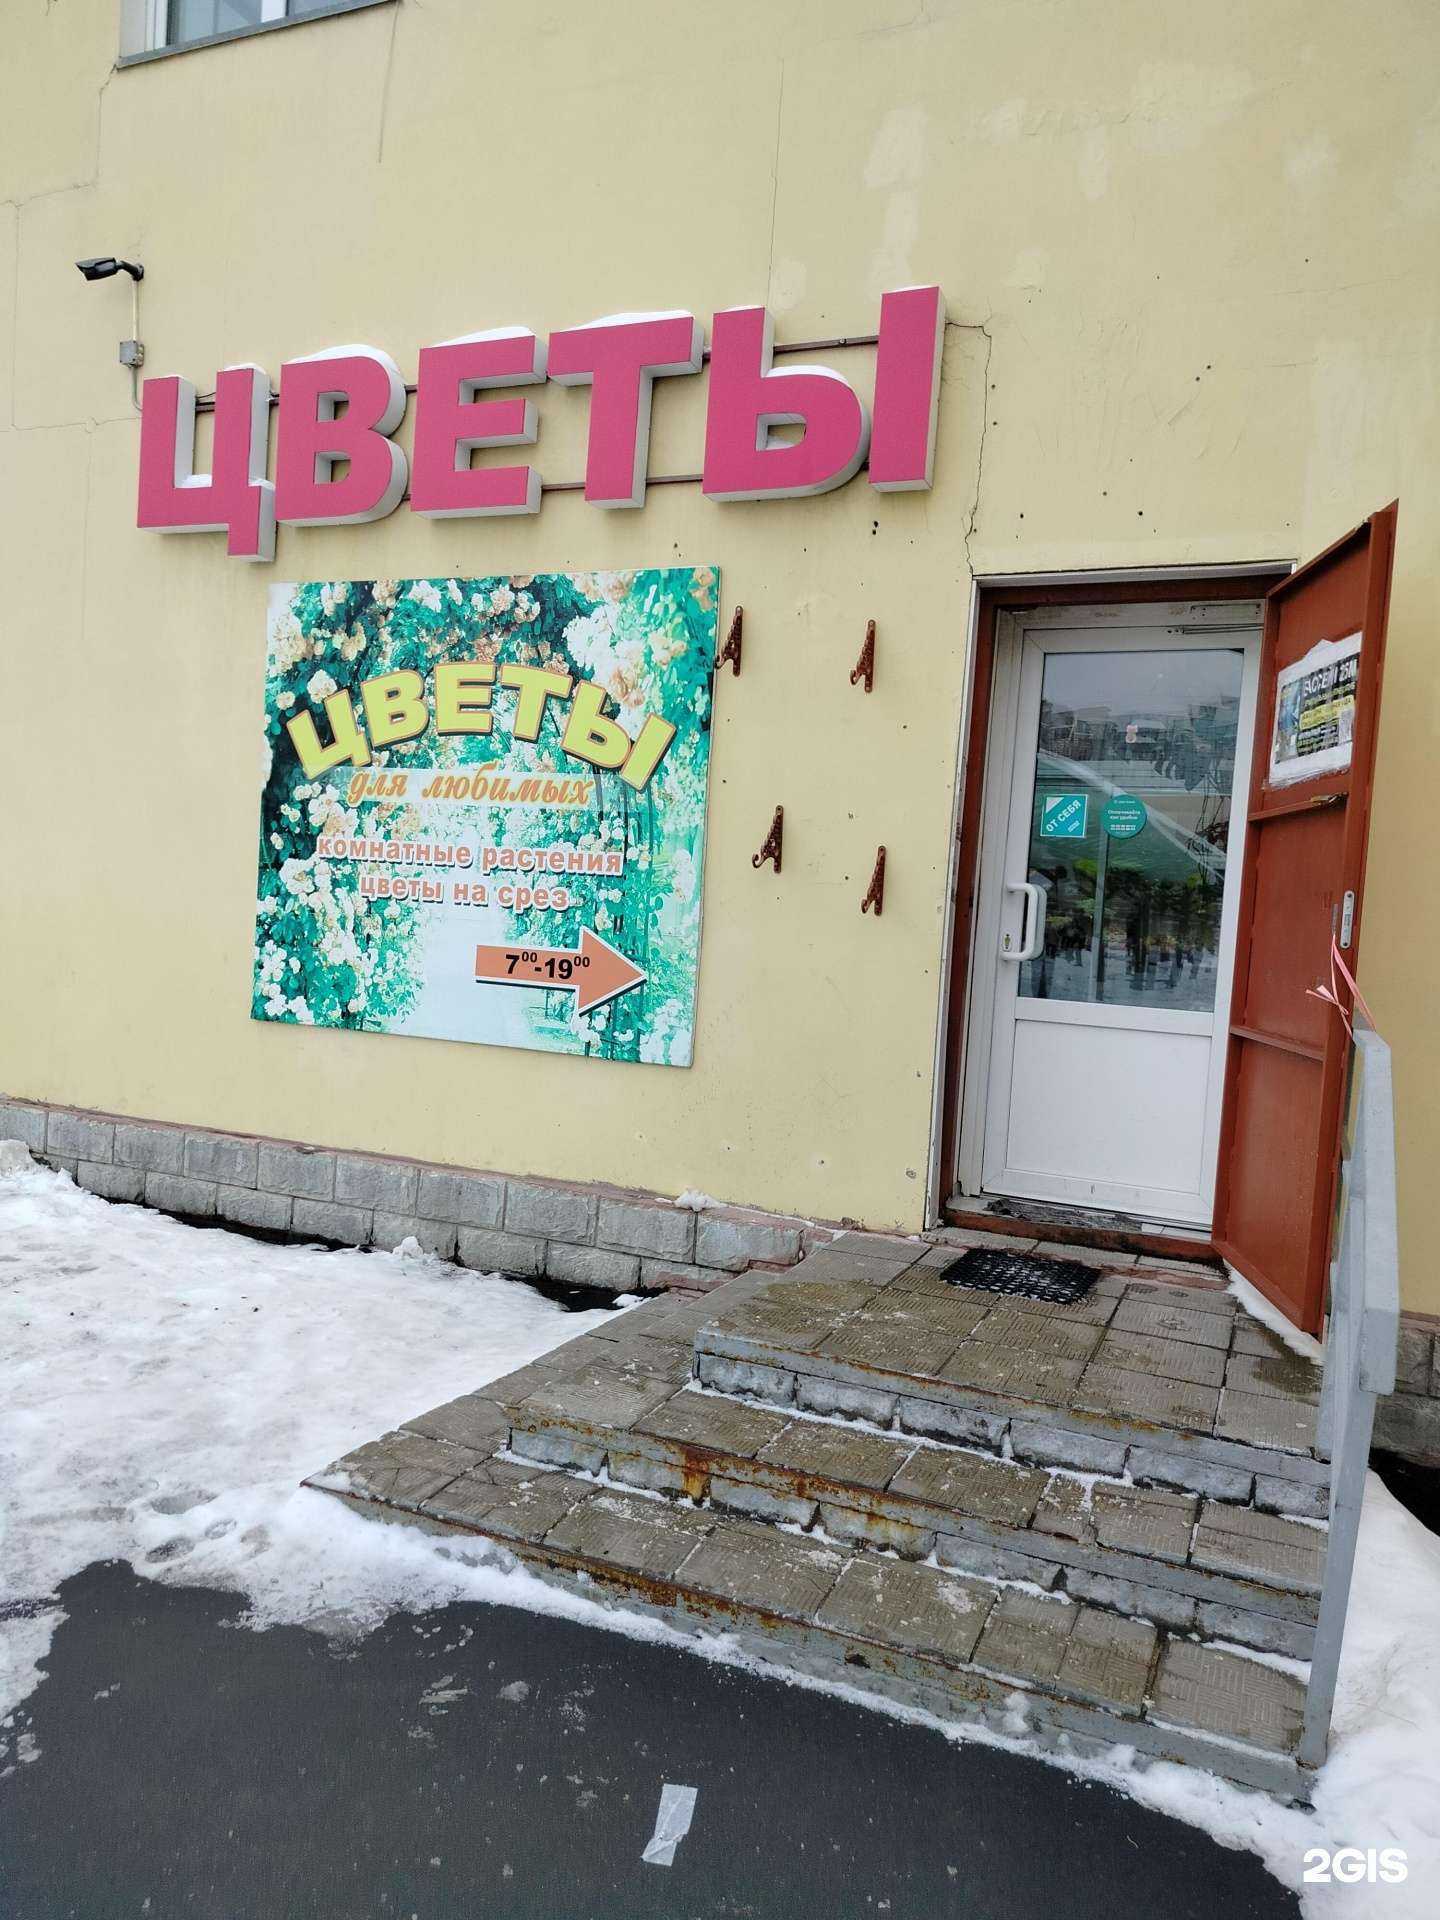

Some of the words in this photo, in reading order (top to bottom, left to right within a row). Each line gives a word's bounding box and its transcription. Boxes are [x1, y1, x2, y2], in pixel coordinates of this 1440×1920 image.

[137, 286, 942, 559] ЦВЕТЫ
[286, 662, 677, 791] ЦВЕТЫ
[348, 770, 408, 805] для
[422, 760, 595, 805] любимых
[1046, 818, 1059, 832] ОТ
[1057, 799, 1082, 822] СЕБЯ
[318, 837, 471, 867] комнатные
[482, 847, 623, 874] растения
[360, 876, 443, 899] цветы
[454, 882, 486, 901] на
[498, 886, 569, 910] срез
